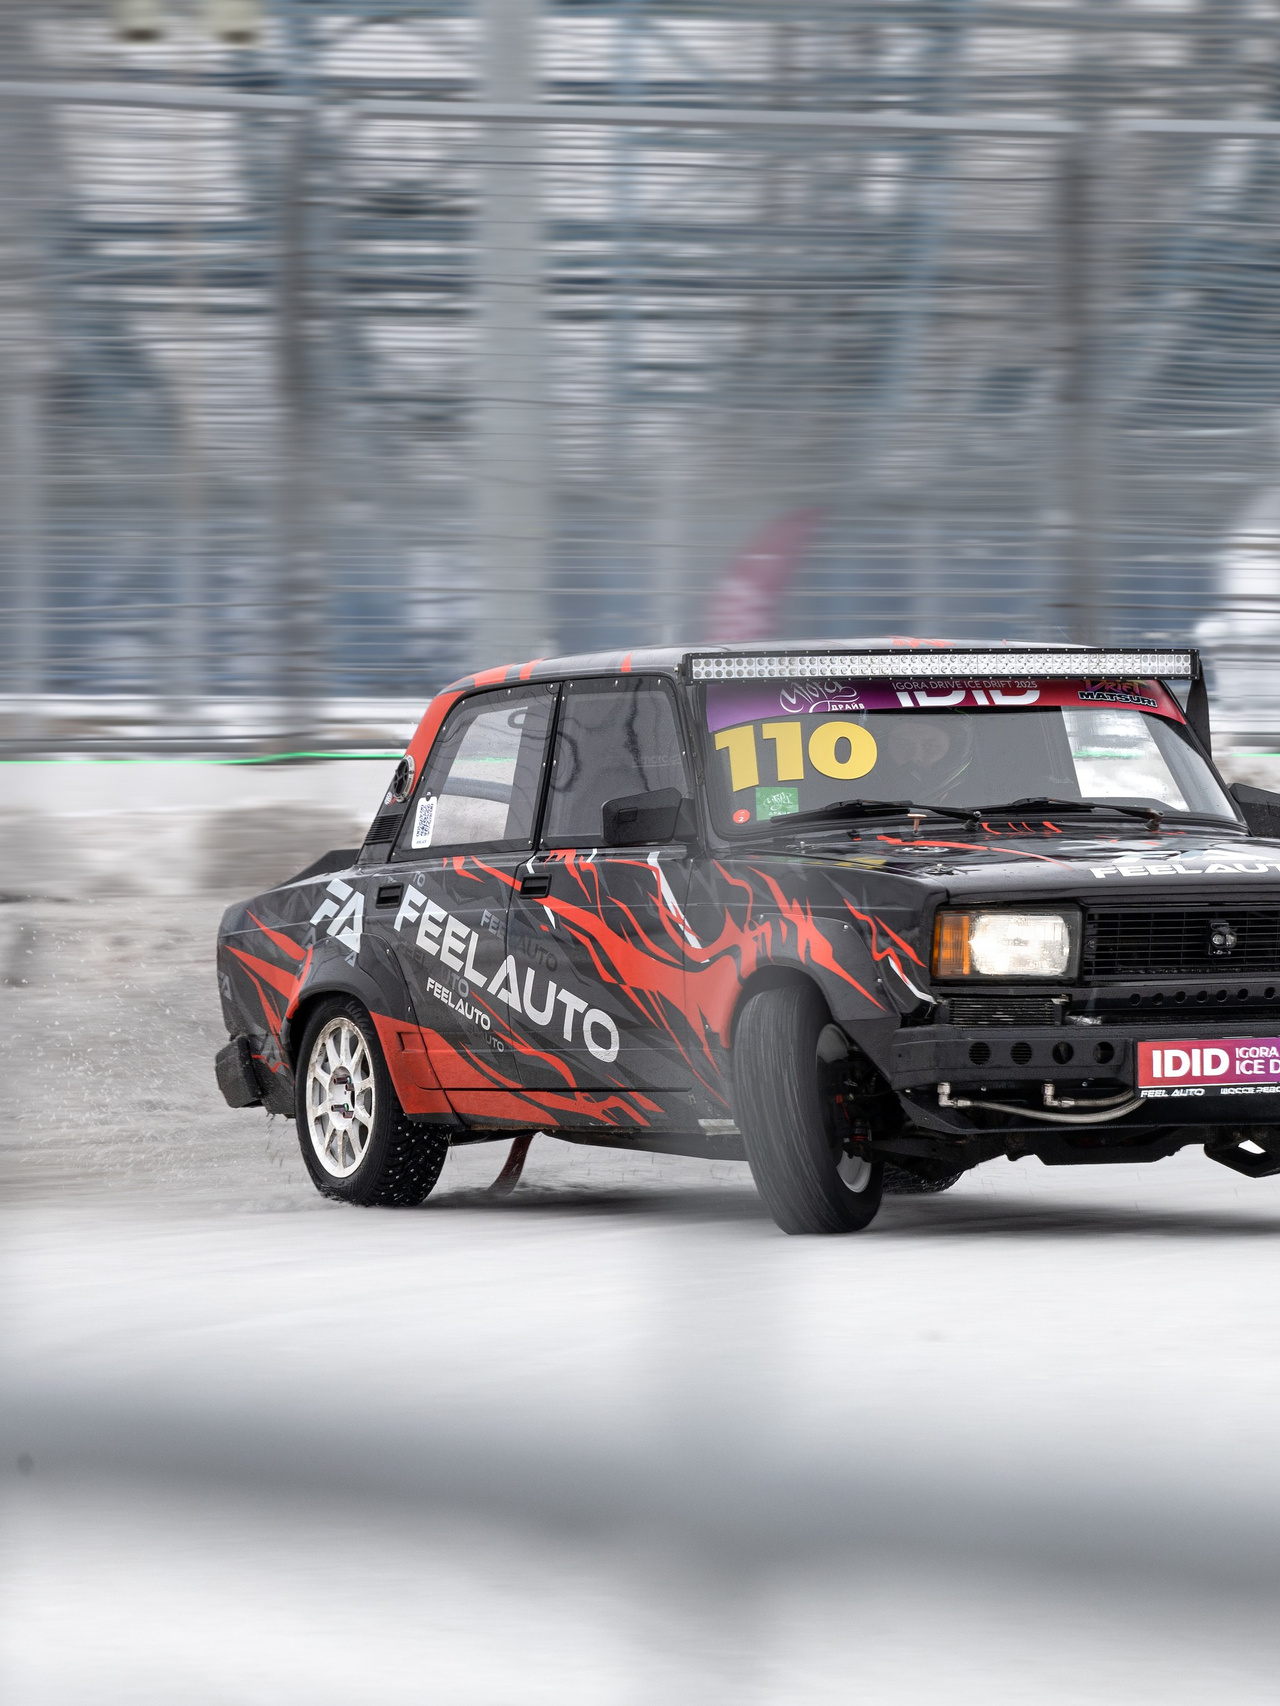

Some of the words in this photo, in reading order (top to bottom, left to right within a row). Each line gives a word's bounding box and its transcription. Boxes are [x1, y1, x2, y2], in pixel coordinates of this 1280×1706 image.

[892, 681, 928, 690] IGORA
[929, 681, 963, 689] DRIVE
[965, 681, 982, 689] ICE
[981, 681, 1013, 689] DRIFT
[1014, 681, 1038, 689] 2025
[831, 702, 865, 711] ДРАЙВ
[1078, 690, 1158, 708] MATSURI
[714, 721, 878, 793] 110
[393, 884, 620, 1064] FEELAUTO
[426, 977, 491, 1031] FEELAUTO
[1235, 1047, 1279, 1059] IGORA
[1152, 1047, 1230, 1078] IDID
[1235, 1059, 1265, 1074] ICE
[1140, 1089, 1168, 1098] FEEL
[1171, 1088, 1205, 1097] AUTO
